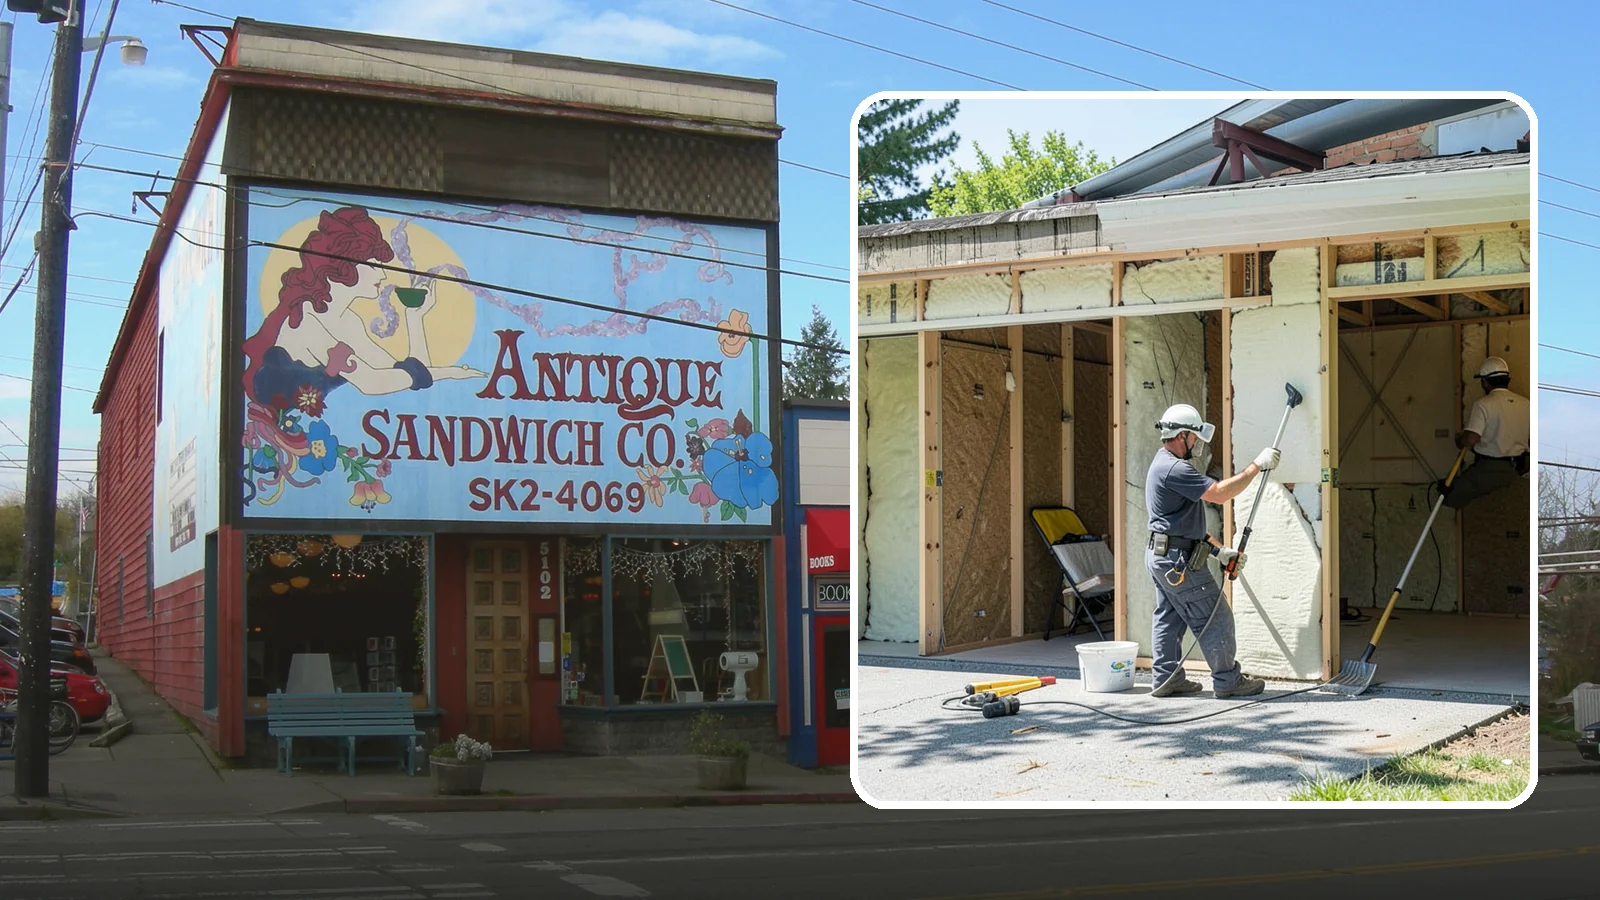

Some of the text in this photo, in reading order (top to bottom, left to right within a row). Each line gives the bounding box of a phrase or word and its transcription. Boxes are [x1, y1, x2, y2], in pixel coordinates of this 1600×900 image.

[477, 329, 724, 421] ANTIQUE
[361, 408, 685, 469] SANDWICH CO.
[468, 477, 646, 514] SK2-4069
[540, 541, 552, 600] 5102
[809, 555, 835, 569] BOOKS
